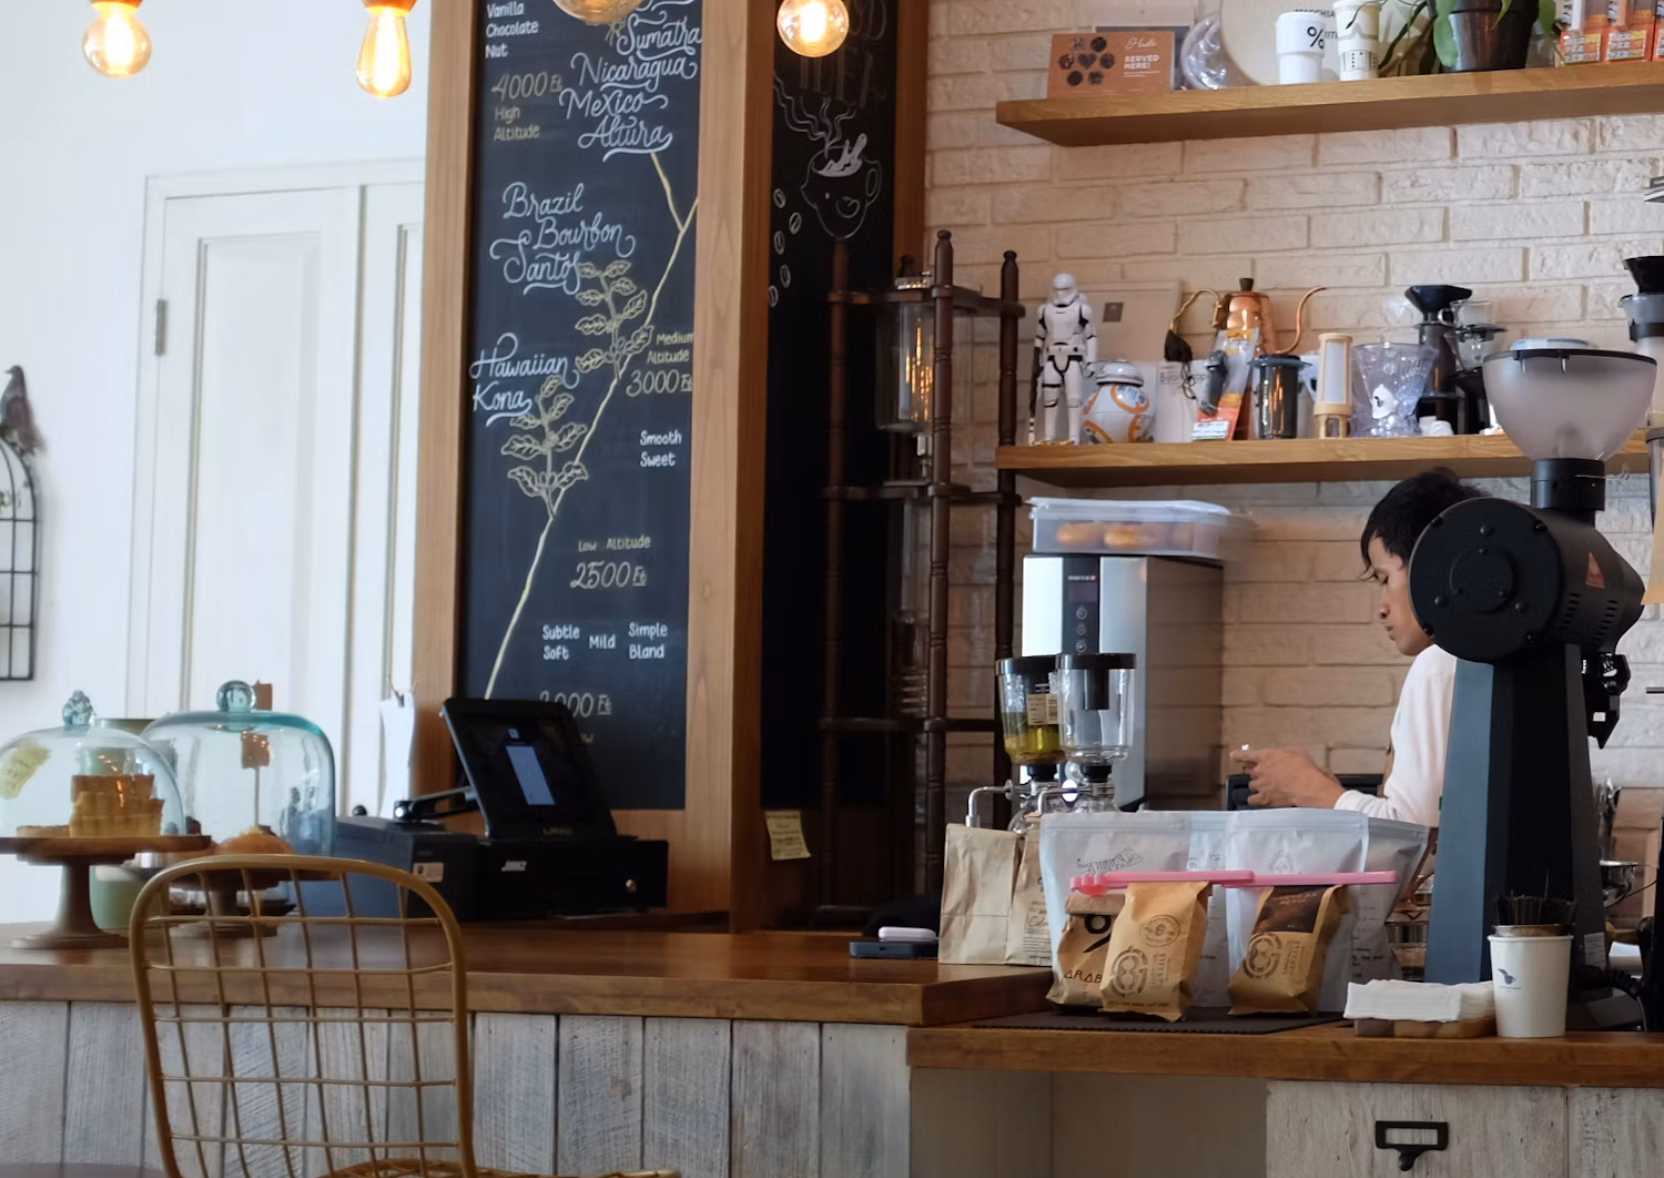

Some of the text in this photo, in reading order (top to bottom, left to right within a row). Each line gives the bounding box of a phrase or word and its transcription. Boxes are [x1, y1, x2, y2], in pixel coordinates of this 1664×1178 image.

[486, 1, 525, 18] Vanilla
[486, 20, 539, 38] Chocolate
[616, 11, 703, 60] Sumatra
[485, 43, 508, 59] Nut
[1125, 54, 1159, 63] SERVED
[570, 52, 698, 93] Nicaragua
[491, 72, 548, 101] 4000
[558, 88, 669, 119] Mexico
[495, 106, 521, 124] High
[493, 124, 540, 141] Altitude
[578, 115, 673, 162] Altura
[502, 181, 585, 222] Brazil
[532, 211, 636, 258] Bourbon
[489, 230, 580, 295] Santos
[469, 332, 580, 389] Hawaiian
[646, 349, 690, 365] Altitude
[626, 369, 680, 397] 3000
[472, 381, 533, 427] Kona
[640, 429, 682, 446] Smooth
[640, 451, 676, 467] Sweet
[578, 534, 651, 552] Low Altitude
[570, 561, 631, 589] 2500
[542, 624, 581, 640] Subtle
[628, 622, 668, 641] Simple
[589, 633, 616, 649] Mild
[543, 645, 570, 661] Soft
[629, 644, 665, 659] Bland
